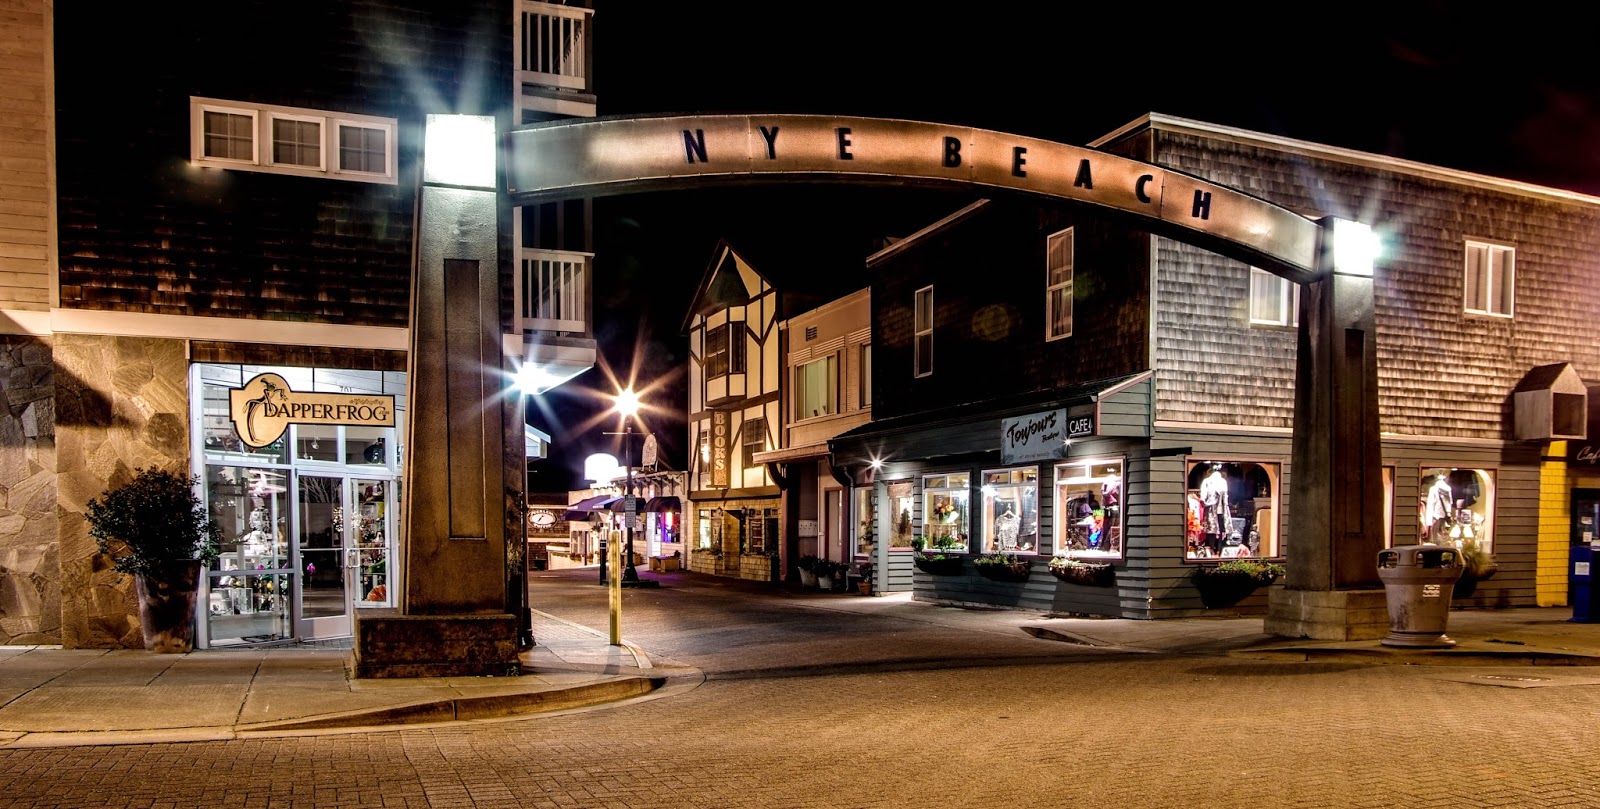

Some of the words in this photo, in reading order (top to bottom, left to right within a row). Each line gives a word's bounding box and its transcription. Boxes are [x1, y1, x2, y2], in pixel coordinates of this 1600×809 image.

[678, 125, 854, 164] NYE
[941, 135, 1212, 221] BEACH
[714, 413, 726, 471] BOOKS
[1006, 411, 1057, 449] Toujours
[1069, 418, 1088, 434] CAFE
